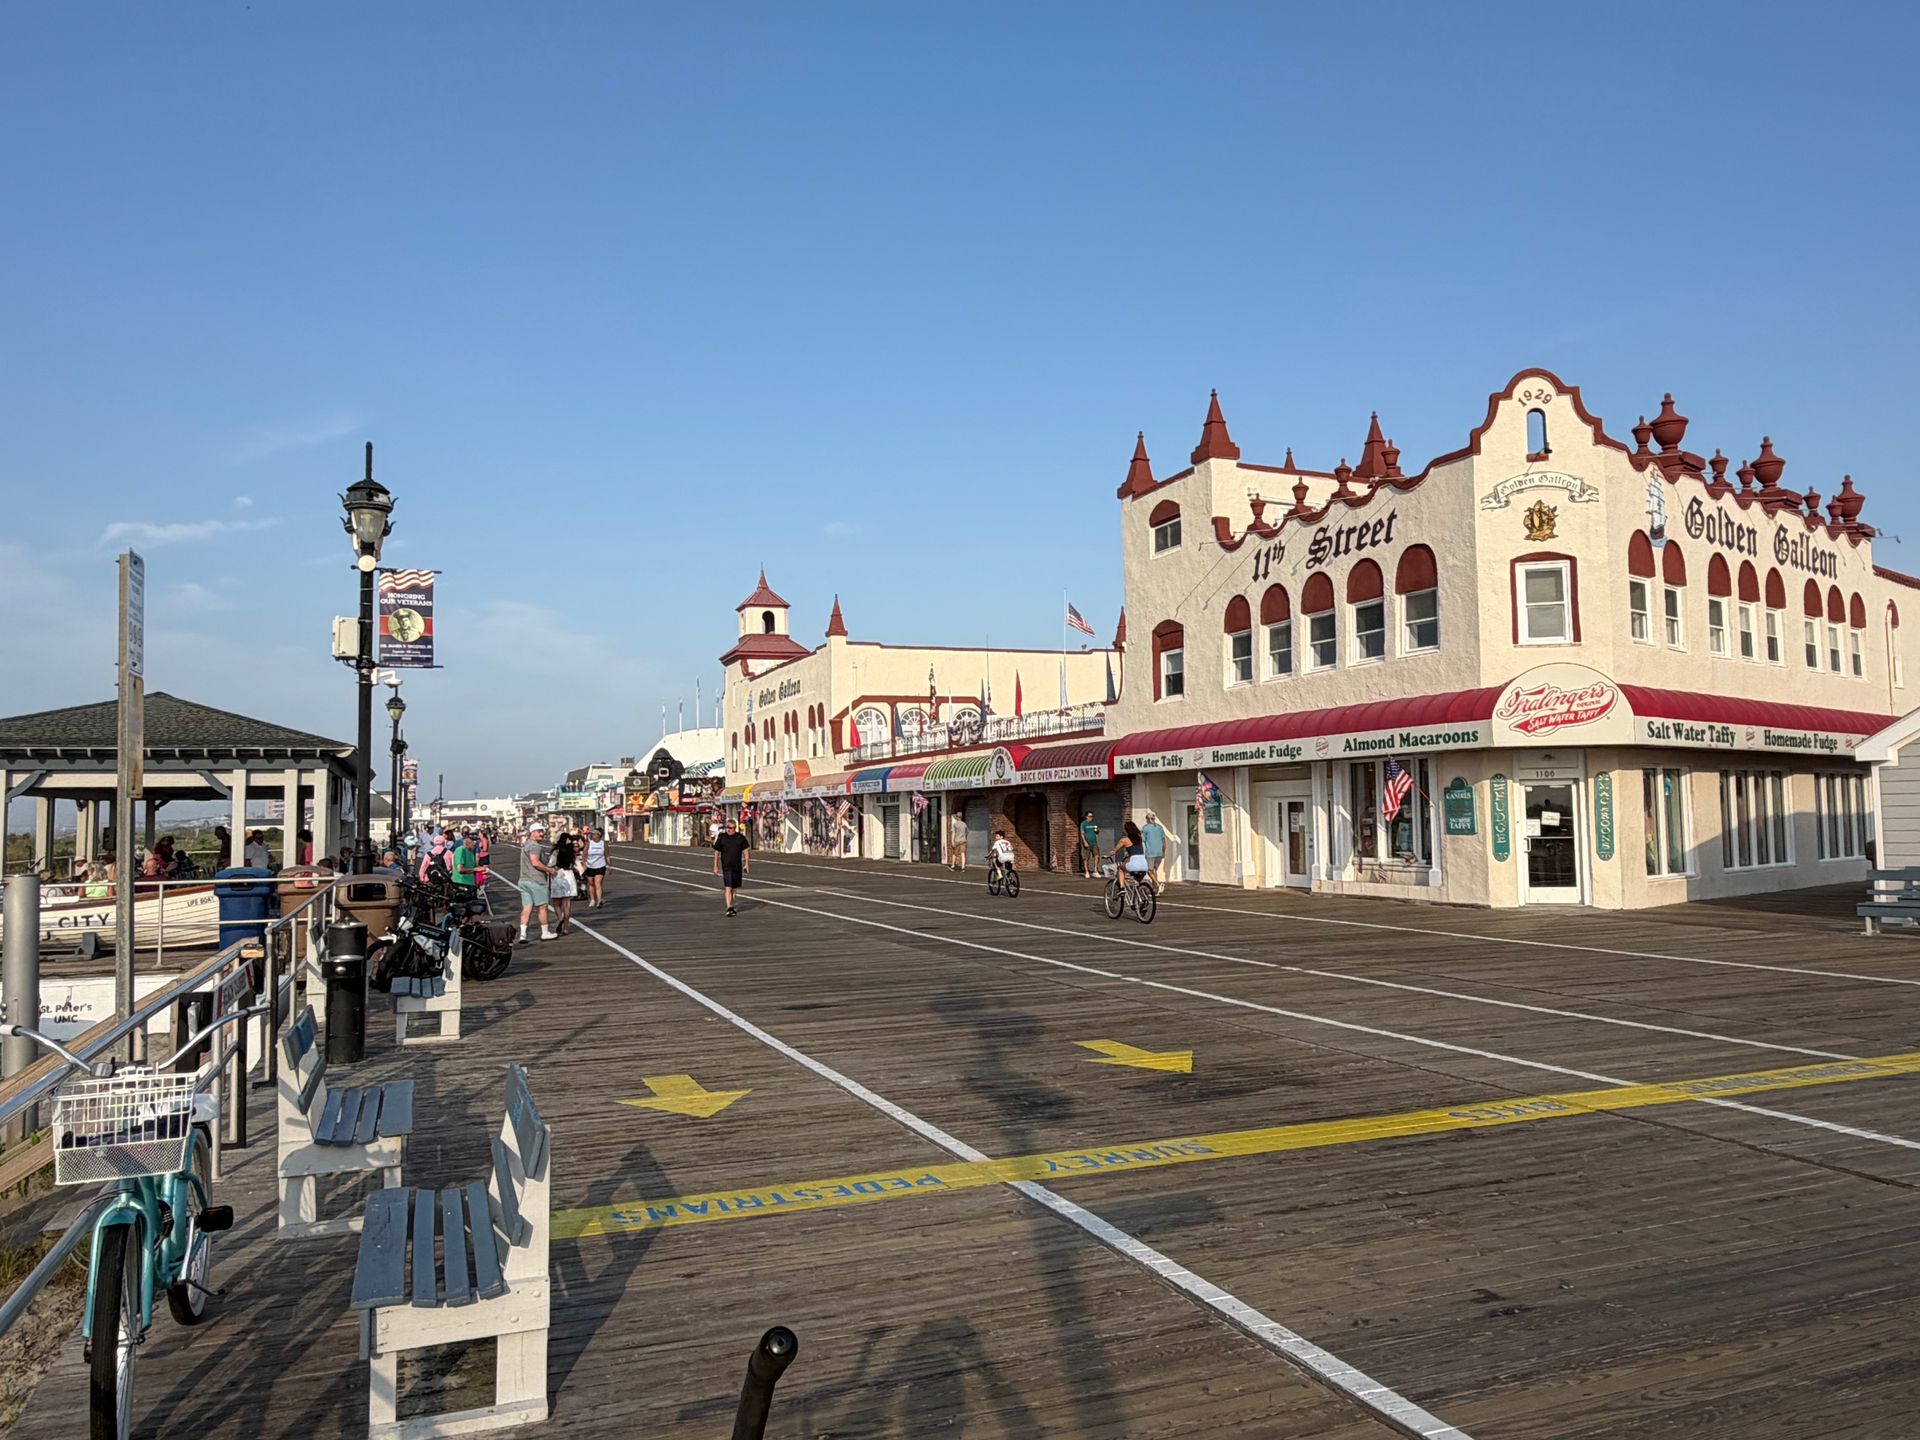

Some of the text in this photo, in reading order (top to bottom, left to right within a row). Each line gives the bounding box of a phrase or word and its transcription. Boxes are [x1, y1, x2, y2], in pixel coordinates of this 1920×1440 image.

[1518, 389, 1552, 407] 1929
[1501, 476, 1535, 495] Golden
[1252, 507, 1398, 583] 11th Street
[1685, 496, 1838, 580] Golden Galleon
[1343, 734, 1395, 752] Almond
[1400, 730, 1479, 748] Macaroons
[1647, 721, 1670, 740] Salt
[1672, 722, 1706, 742] Water
[1708, 725, 1736, 747] Taffy
[1764, 730, 1812, 748] Homemade
[1814, 733, 1838, 753] Fudge
[1119, 759, 1134, 770] Salt
[1135, 756, 1158, 768] Water
[1161, 755, 1183, 768] Taffy
[1212, 747, 1266, 763] Homemade
[1269, 744, 1302, 761] Fudge
[1536, 770, 1556, 778] 1100
[58, 913, 110, 928] CITY
[41, 1003, 93, 1014] St. Peter's
[54, 1015, 79, 1023] UMC
[611, 1173, 943, 1226] PEDESTRIANS
